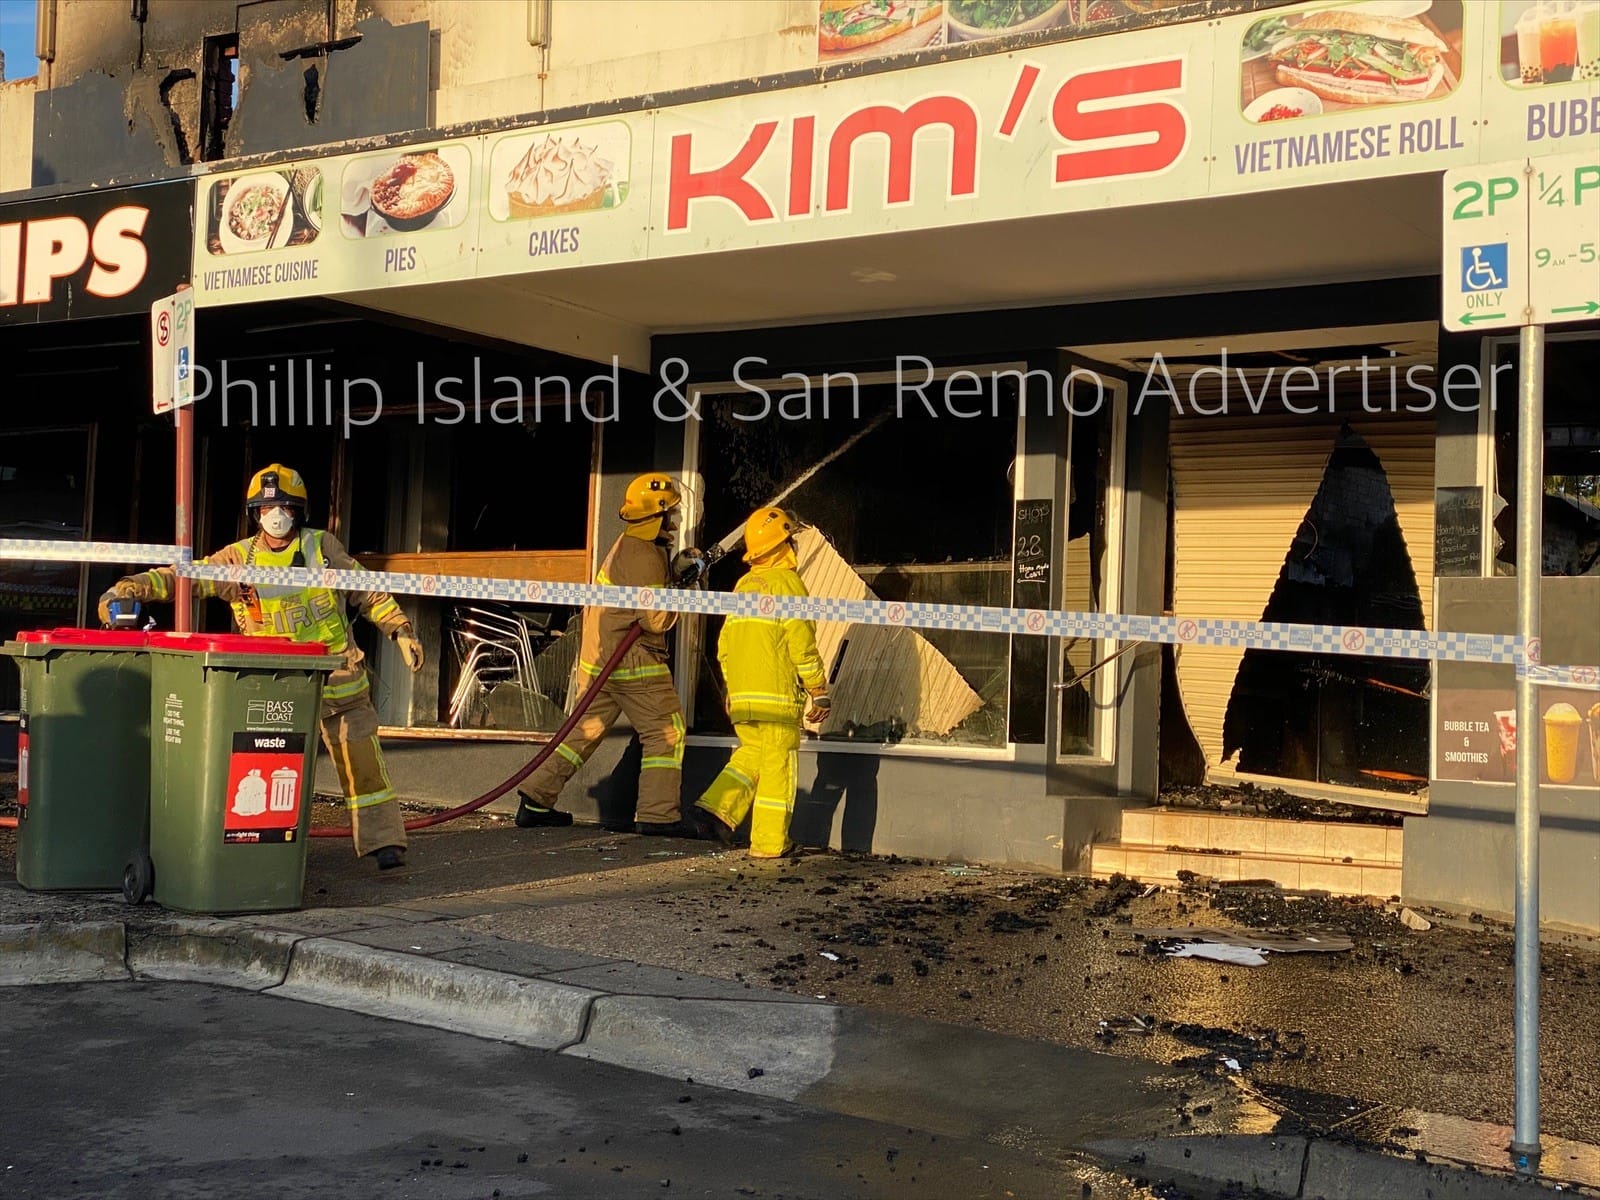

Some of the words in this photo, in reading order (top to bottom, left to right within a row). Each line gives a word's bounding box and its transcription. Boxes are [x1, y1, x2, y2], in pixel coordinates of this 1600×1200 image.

[667, 59, 1187, 231] KIM'S
[1234, 125, 1391, 175] VIETNAMESE
[1399, 116, 1464, 155] ROLL
[1452, 176, 1519, 220] 2P
[528, 227, 580, 257] CAKES
[384, 247, 417, 273] PIES
[203, 263, 271, 291] VIETNAMESE
[273, 259, 319, 286] CUISINE
[1466, 292, 1503, 308] ONLY
[176, 300, 192, 333] 2P
[266, 712, 293, 721] COAST
[267, 701, 294, 713] BASS
[1444, 721, 1473, 732] BUBBLE
[1475, 721, 1490, 732] TEA
[254, 737, 286, 748] waste
[1463, 736, 1470, 747] &
[1444, 752, 1489, 764] SMOOTHIES
